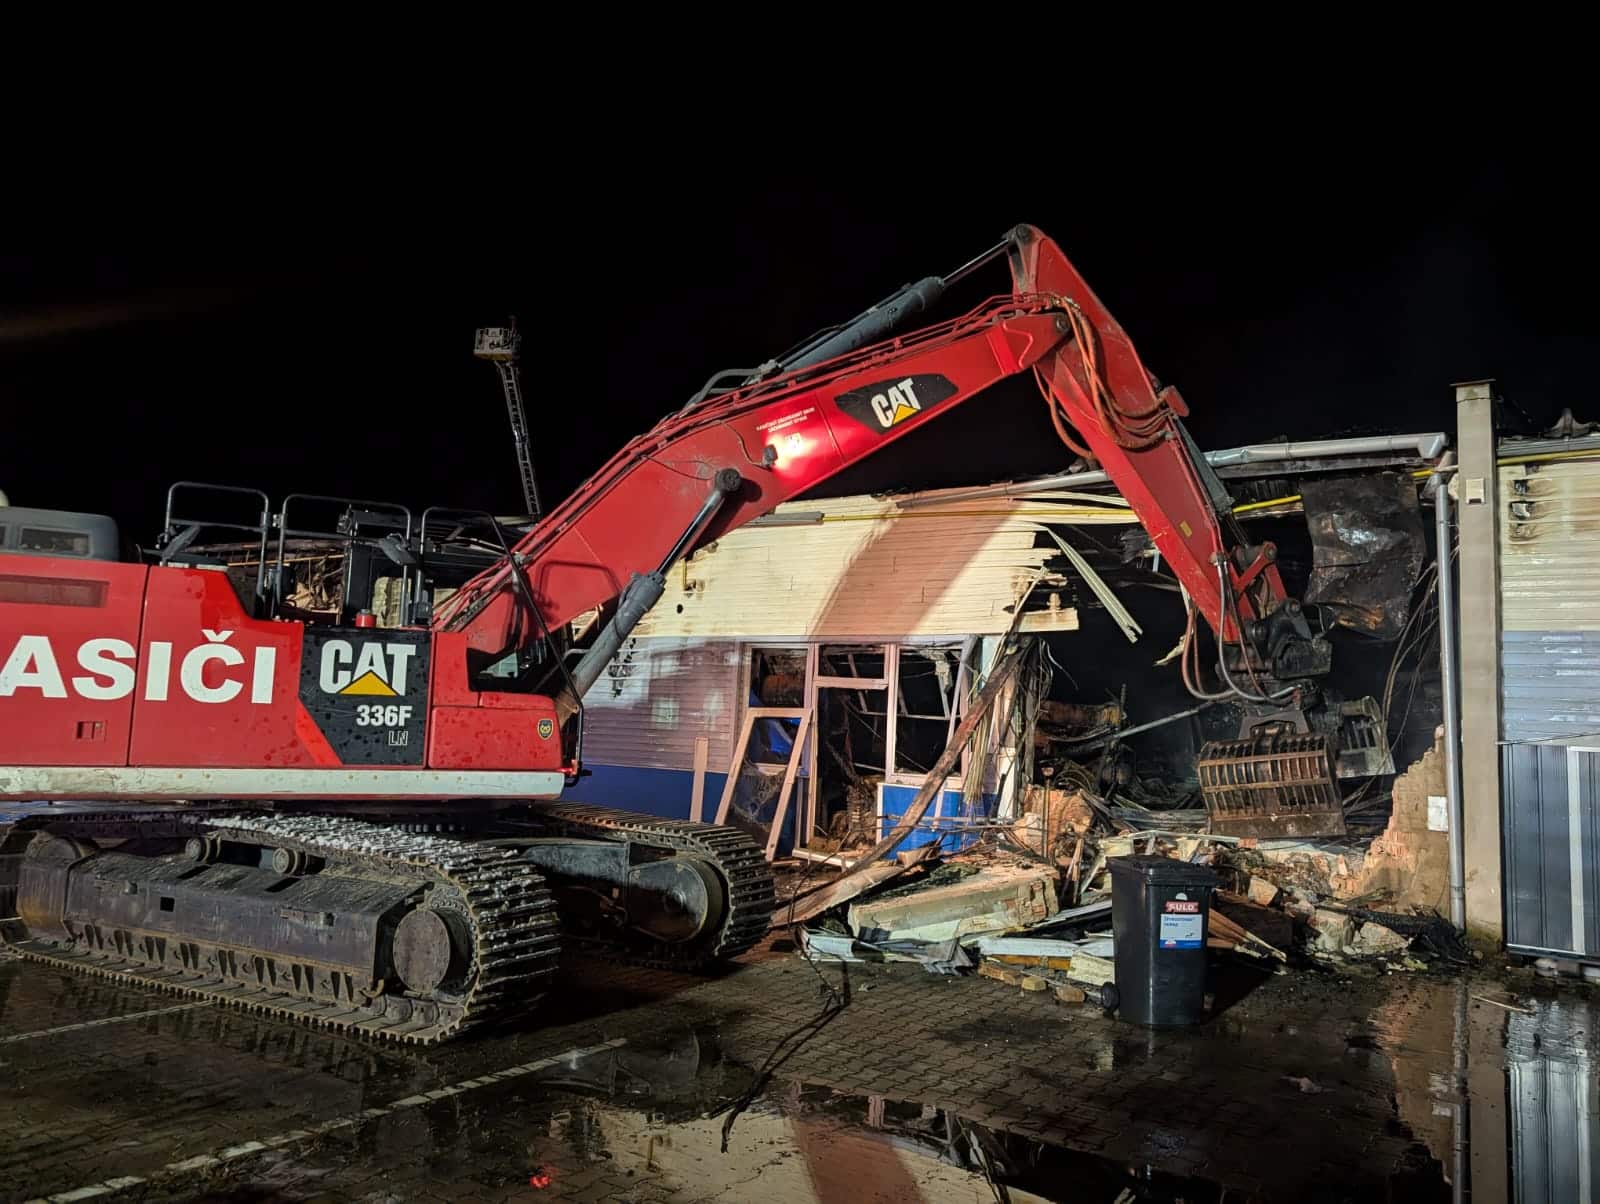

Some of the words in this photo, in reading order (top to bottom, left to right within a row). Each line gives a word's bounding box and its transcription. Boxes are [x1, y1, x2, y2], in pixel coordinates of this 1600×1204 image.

[871, 378, 921, 428] CAT
[0, 629, 276, 704] ASIČI
[320, 640, 416, 696] CAT
[356, 704, 413, 727] 336F
[388, 730, 408, 746] LN
